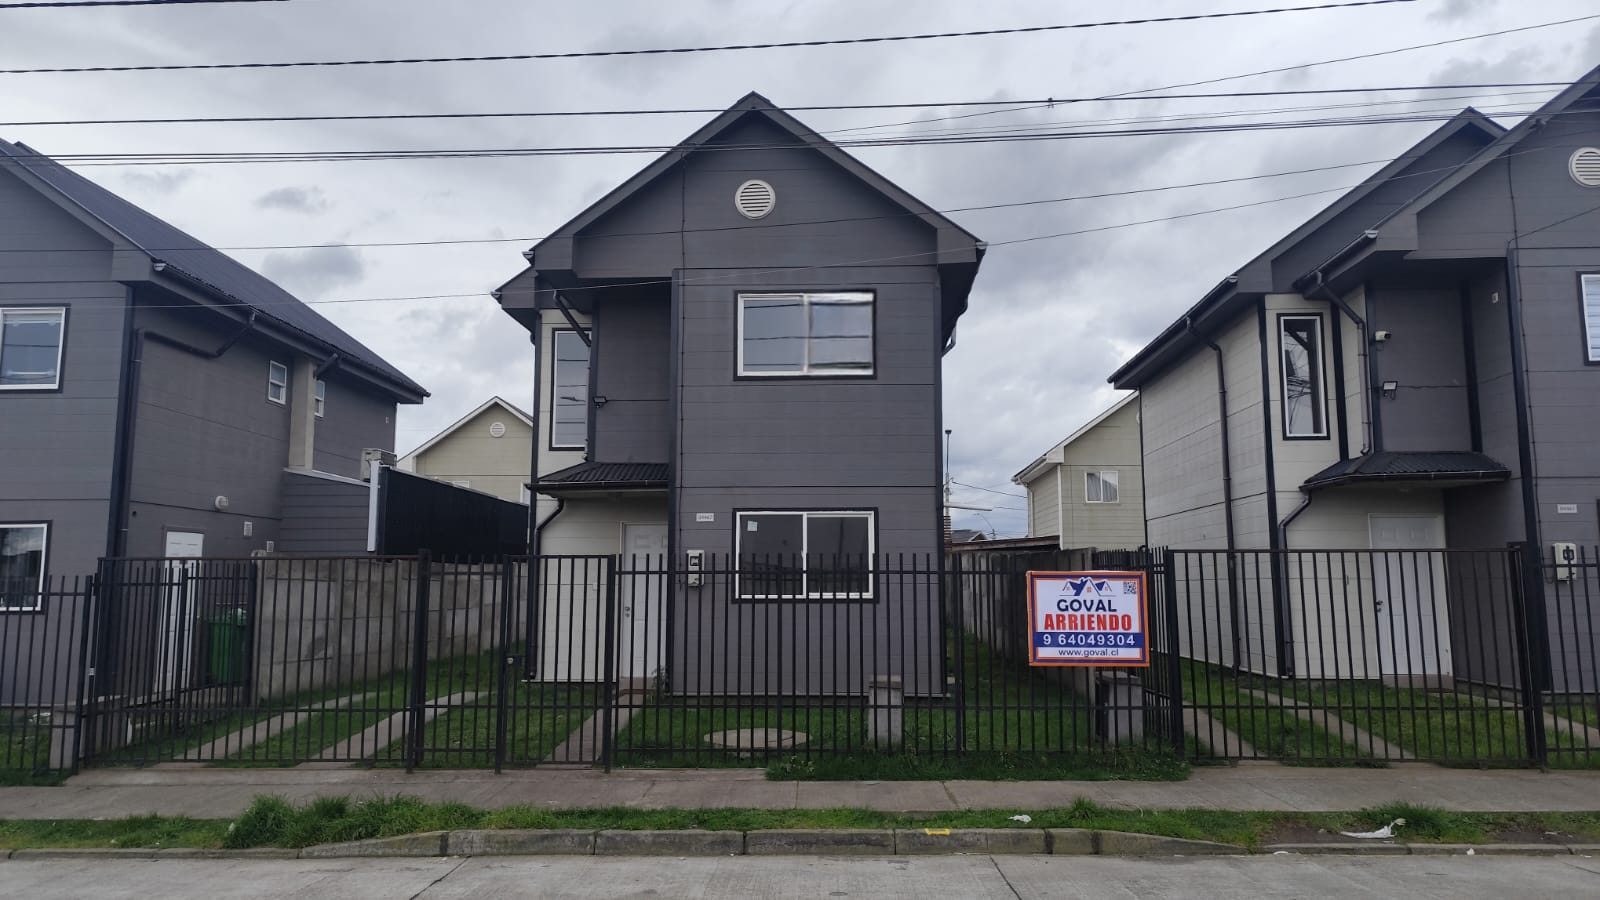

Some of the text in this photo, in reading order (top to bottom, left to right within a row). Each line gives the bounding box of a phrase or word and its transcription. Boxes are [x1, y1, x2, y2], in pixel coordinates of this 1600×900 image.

[1057, 599, 1117, 612] GOVAL
[1044, 614, 1132, 631] ARRIENDO
[1043, 634, 1135, 645] 9 64049304
[1058, 648, 1119, 657] www.goval.cl
